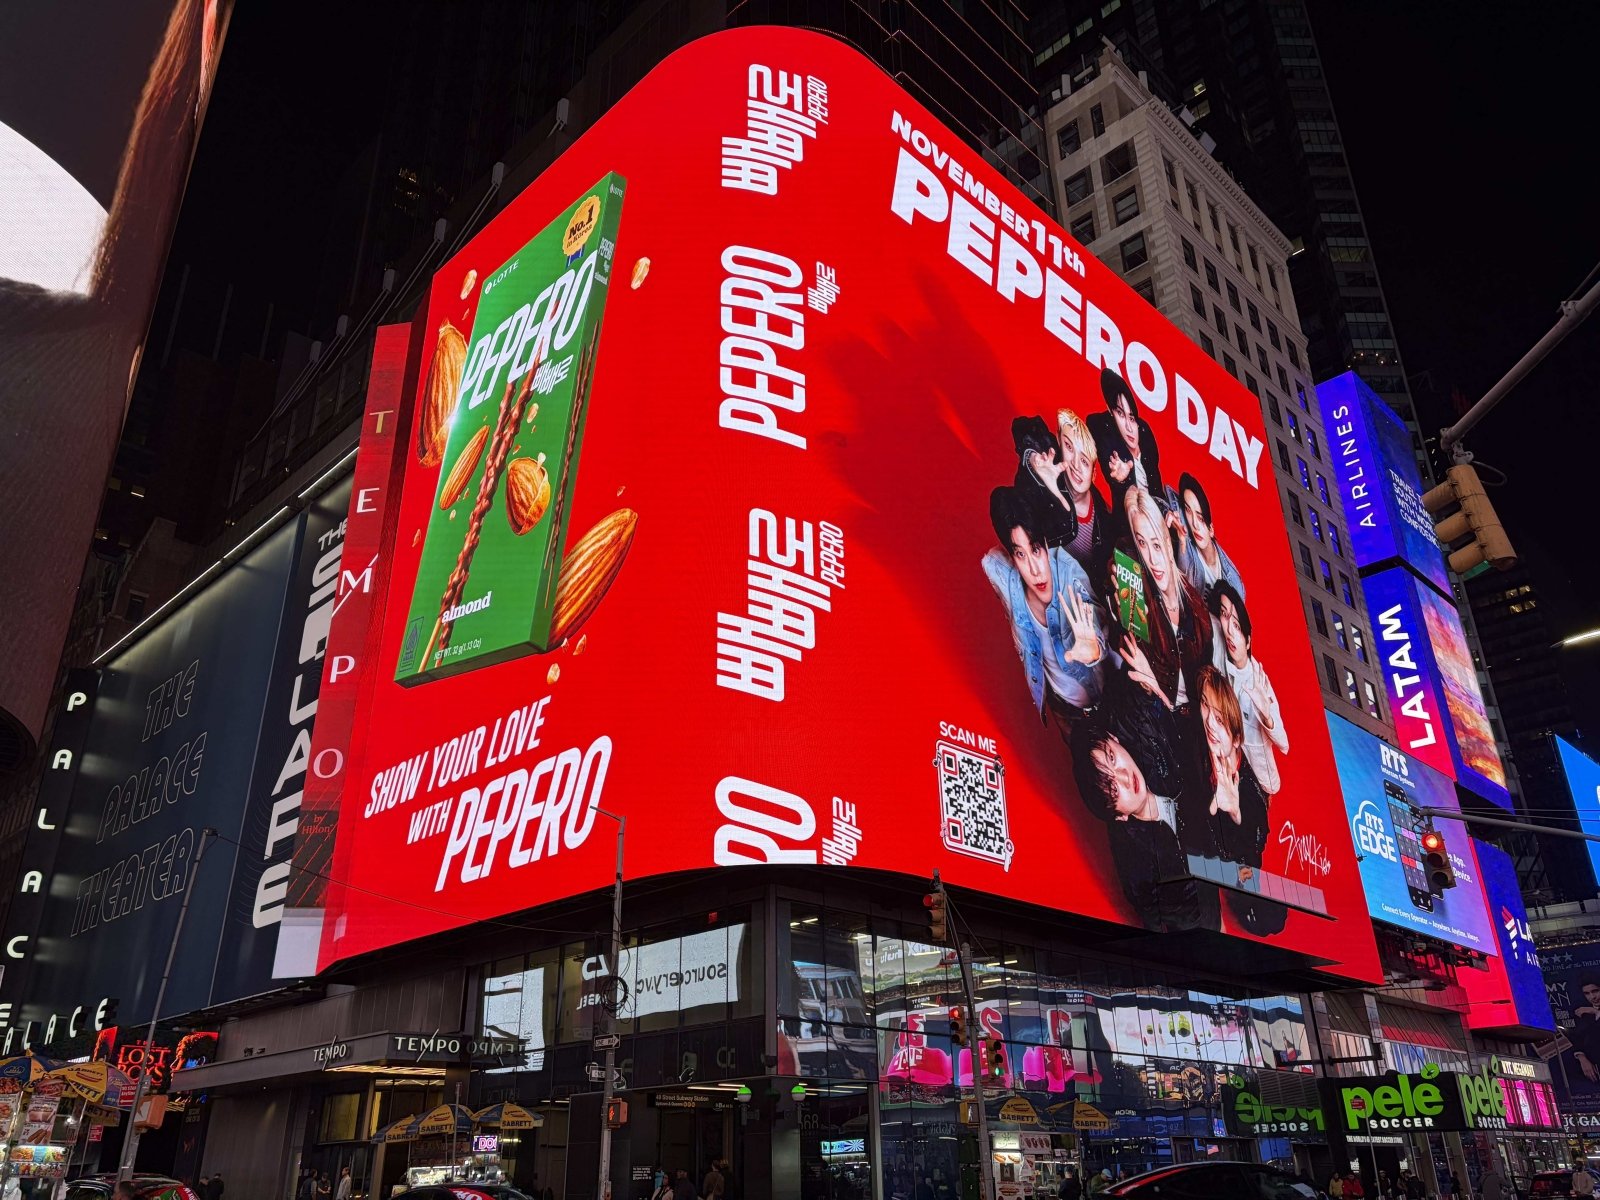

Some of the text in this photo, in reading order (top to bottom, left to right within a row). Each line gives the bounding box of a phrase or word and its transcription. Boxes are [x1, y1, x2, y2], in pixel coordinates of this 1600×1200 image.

[806, 74, 828, 125] PEPERO
[890, 110, 1086, 278] NOVEMBER 11th
[567, 204, 596, 240] No.1
[492, 258, 520, 288] LOTTE
[460, 250, 598, 410] PEPERO
[890, 146, 1264, 491] PEPERO DAY
[718, 244, 807, 450] PEPERO
[1333, 405, 1376, 527] AIRLINES
[1393, 482, 1418, 510] SOUTH
[819, 520, 846, 590] PEPERO
[1116, 563, 1144, 593] PEPERO
[441, 591, 492, 624] almond
[1378, 604, 1436, 749] LATAM
[142, 659, 199, 743] THE
[939, 721, 998, 755] SCAN ME
[364, 695, 551, 819] SHOW YOUR LOVE
[1380, 743, 1409, 777] RTS
[96, 732, 207, 845] PALACE
[301, 823, 331, 836] Hilton
[406, 735, 613, 893] WITH PEPERO
[1364, 811, 1385, 833] RTS
[1358, 826, 1397, 863] EDGE
[71, 828, 194, 937] THEATER
[314, 1039, 347, 1067] TEMPO
[395, 1033, 460, 1057] TEMPO
[1341, 1062, 1444, 1130] pelé
[1459, 1055, 1507, 1128] pelé
[420, 1124, 454, 1132] SABRETT
[502, 1120, 532, 1128] SABRETT
[1001, 1113, 1035, 1122] SABRETT
[1369, 1116, 1434, 1129] SOCCER
[1477, 1116, 1507, 1129] SOCCER
